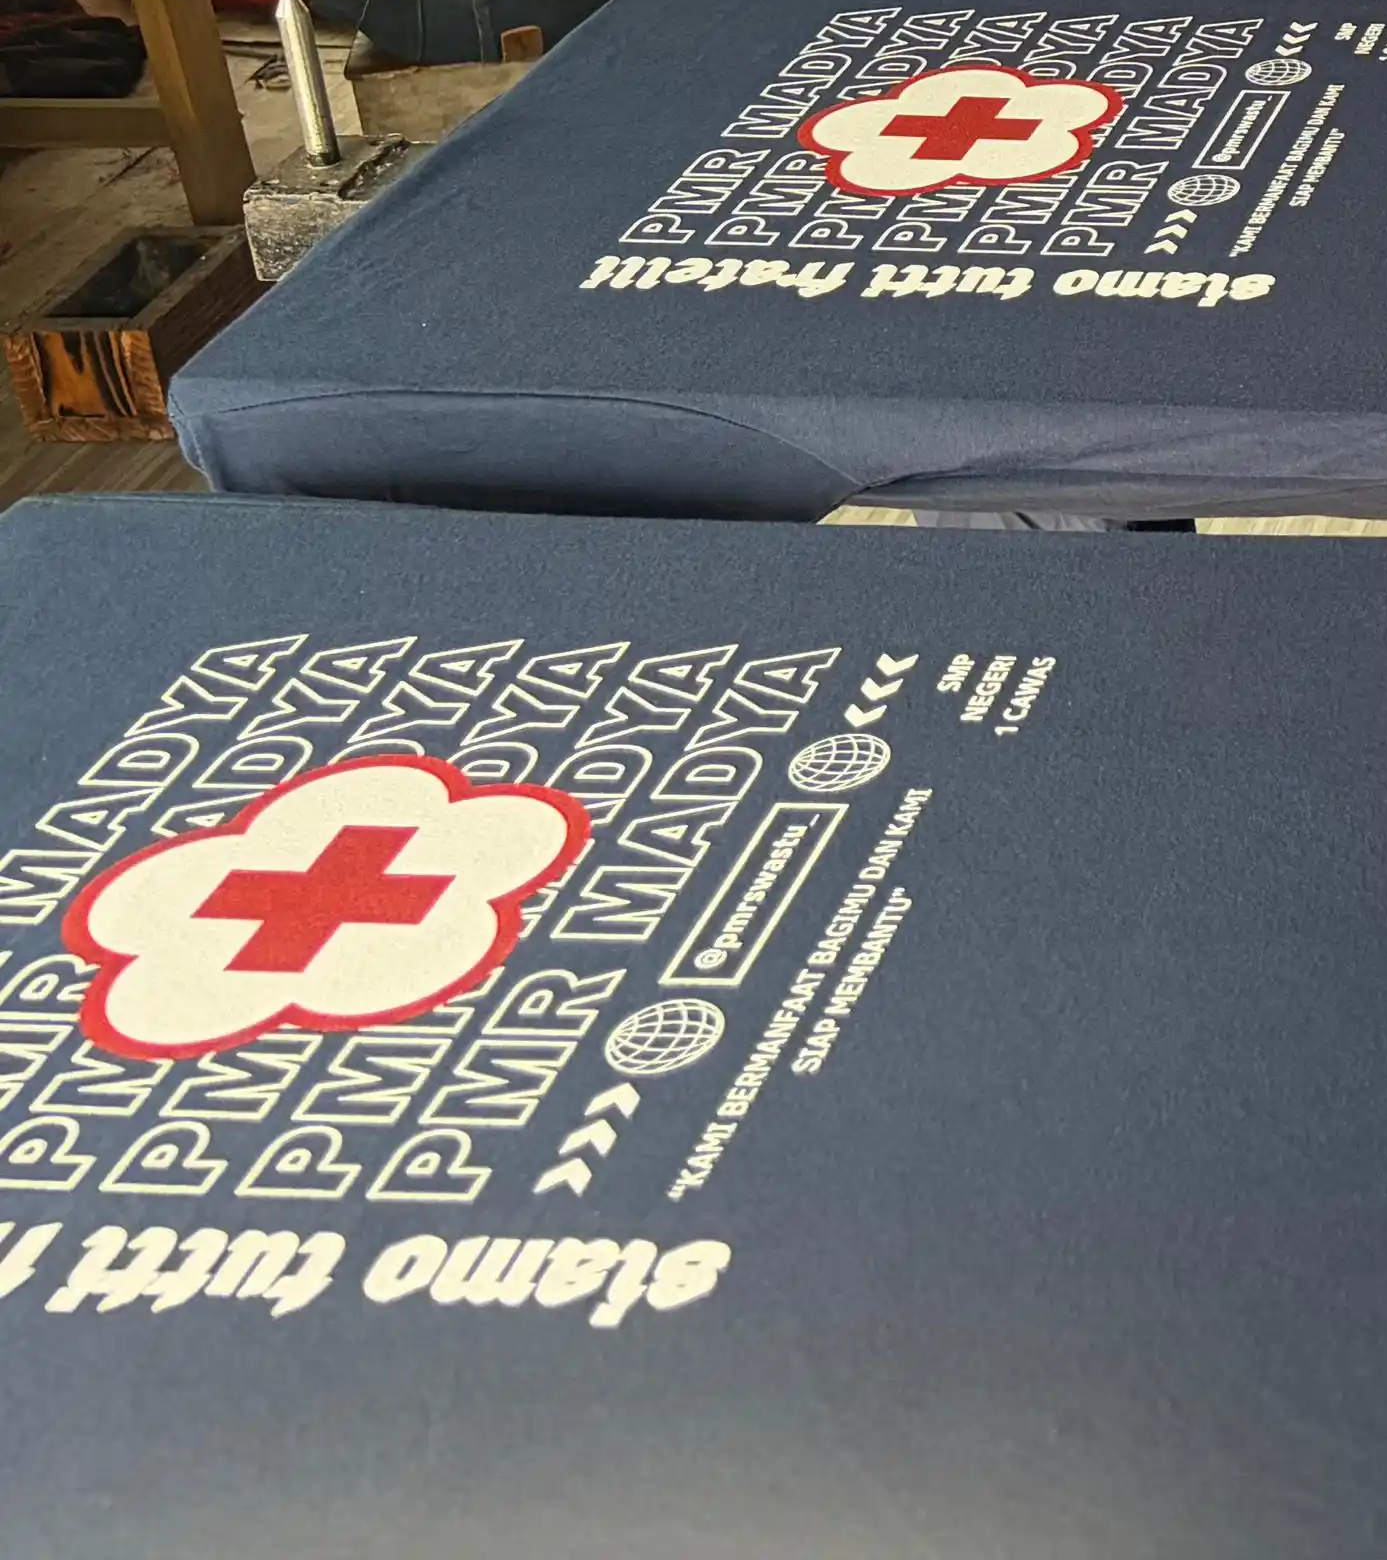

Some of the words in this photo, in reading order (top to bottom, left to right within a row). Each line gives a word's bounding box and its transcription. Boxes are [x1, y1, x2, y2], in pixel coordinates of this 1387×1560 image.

[835, 10, 976, 101] ADYA
[1332, 22, 1356, 41] SMP
[1352, 23, 1384, 55] NEGERI
[617, 149, 771, 244] PMR
[719, 7, 903, 139] MADYA
[1305, 108, 1331, 126] DAN
[1316, 85, 1344, 107] KAMI
[1040, 161, 1170, 256] PMR
[1114, 17, 1263, 150] MADYA
[787, 188, 896, 249] PM
[871, 186, 987, 251] PM
[1286, 185, 1313, 208] SIAP
[577, 255, 855, 297] fratelli
[860, 263, 1035, 300] tutti
[1051, 269, 1273, 306] siamo
[935, 654, 974, 692] SMP
[958, 655, 1017, 722] NEGERI
[1001, 657, 1057, 722] CAWAS
[149, 637, 418, 838] ADYA
[992, 727, 1018, 737] 1
[366, 969, 627, 1201] PMR
[550, 646, 841, 941] MADYA
[693, 816, 818, 971] @pmrswastu_
[715, 971, 822, 1118] BERMANFAAT
[805, 887, 874, 968] BAGIMU
[856, 843, 901, 882] DAN
[882, 791, 931, 839] KAMI
[788, 1021, 837, 1075] SIAP
[0, 1045, 172, 1191] PM
[96, 1034, 325, 1195] PM
[40, 1229, 345, 1316] tutti
[362, 1235, 727, 1324] siamo
